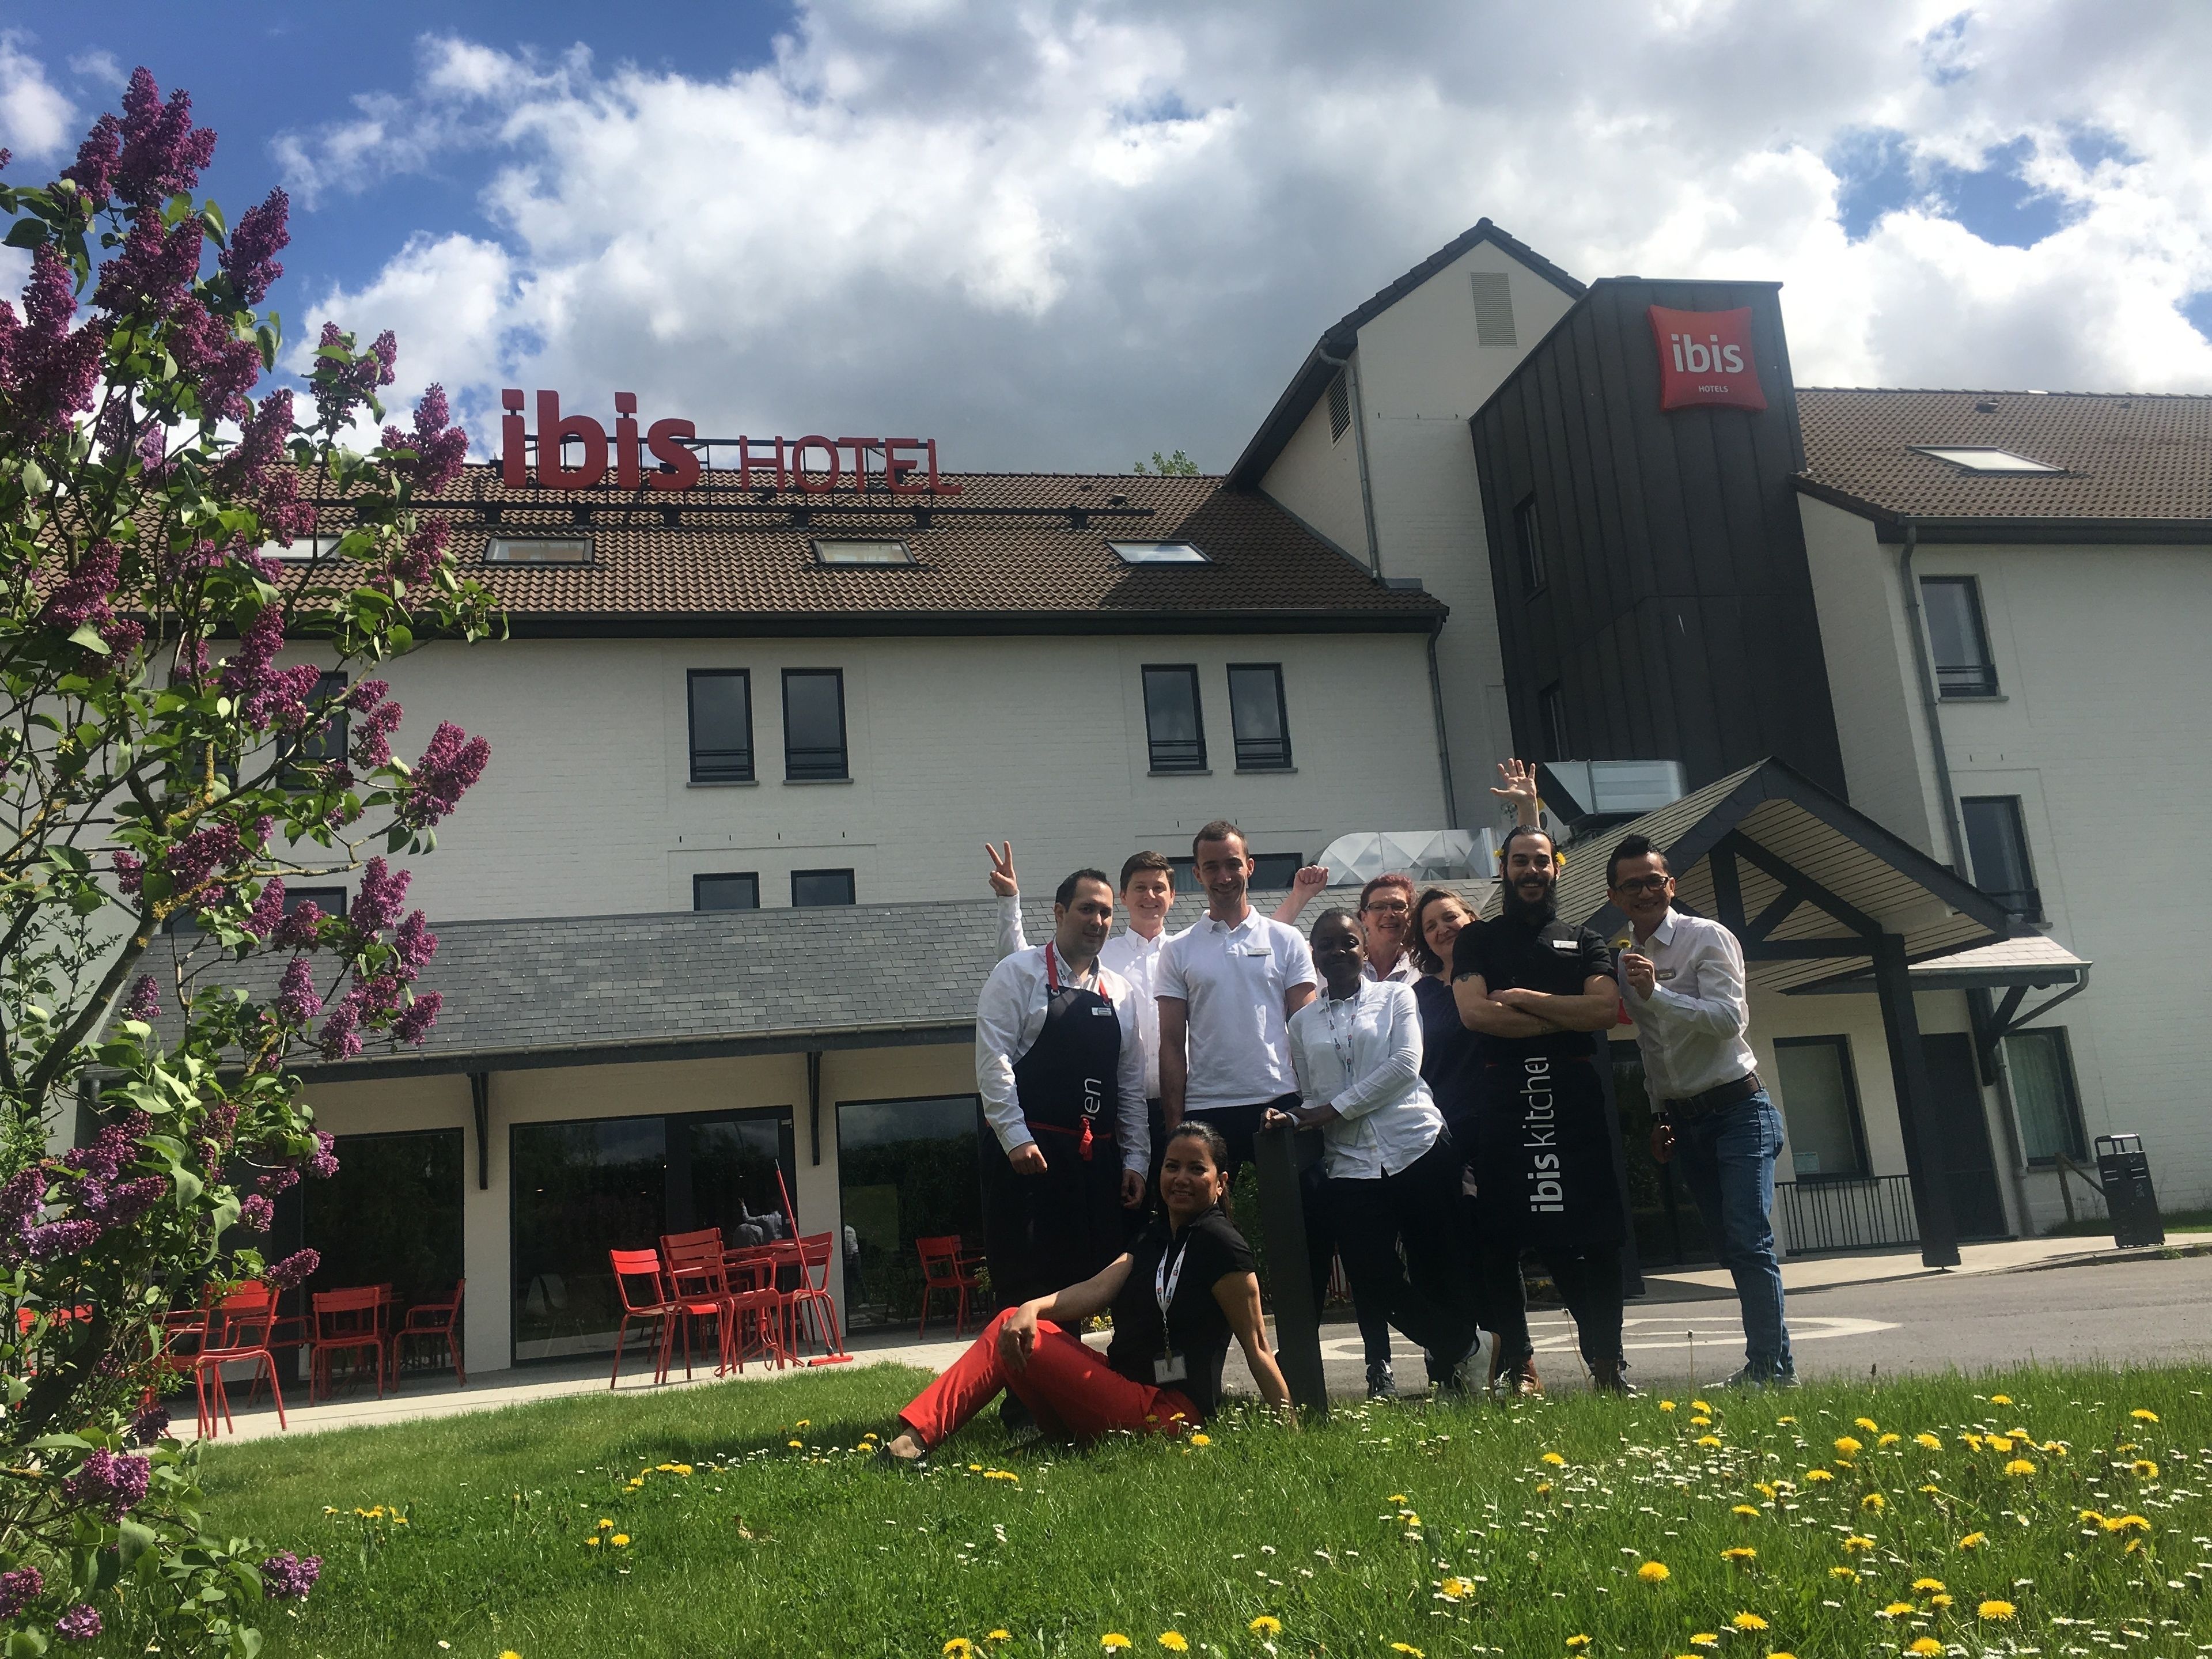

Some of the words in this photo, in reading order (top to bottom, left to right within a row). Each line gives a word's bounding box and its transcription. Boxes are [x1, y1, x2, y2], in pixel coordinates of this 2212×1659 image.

[1671, 334, 1744, 373] ibis
[502, 388, 700, 491] ibis
[739, 435, 963, 495] HOTEL
[1528, 1153, 1565, 1212] ibis
